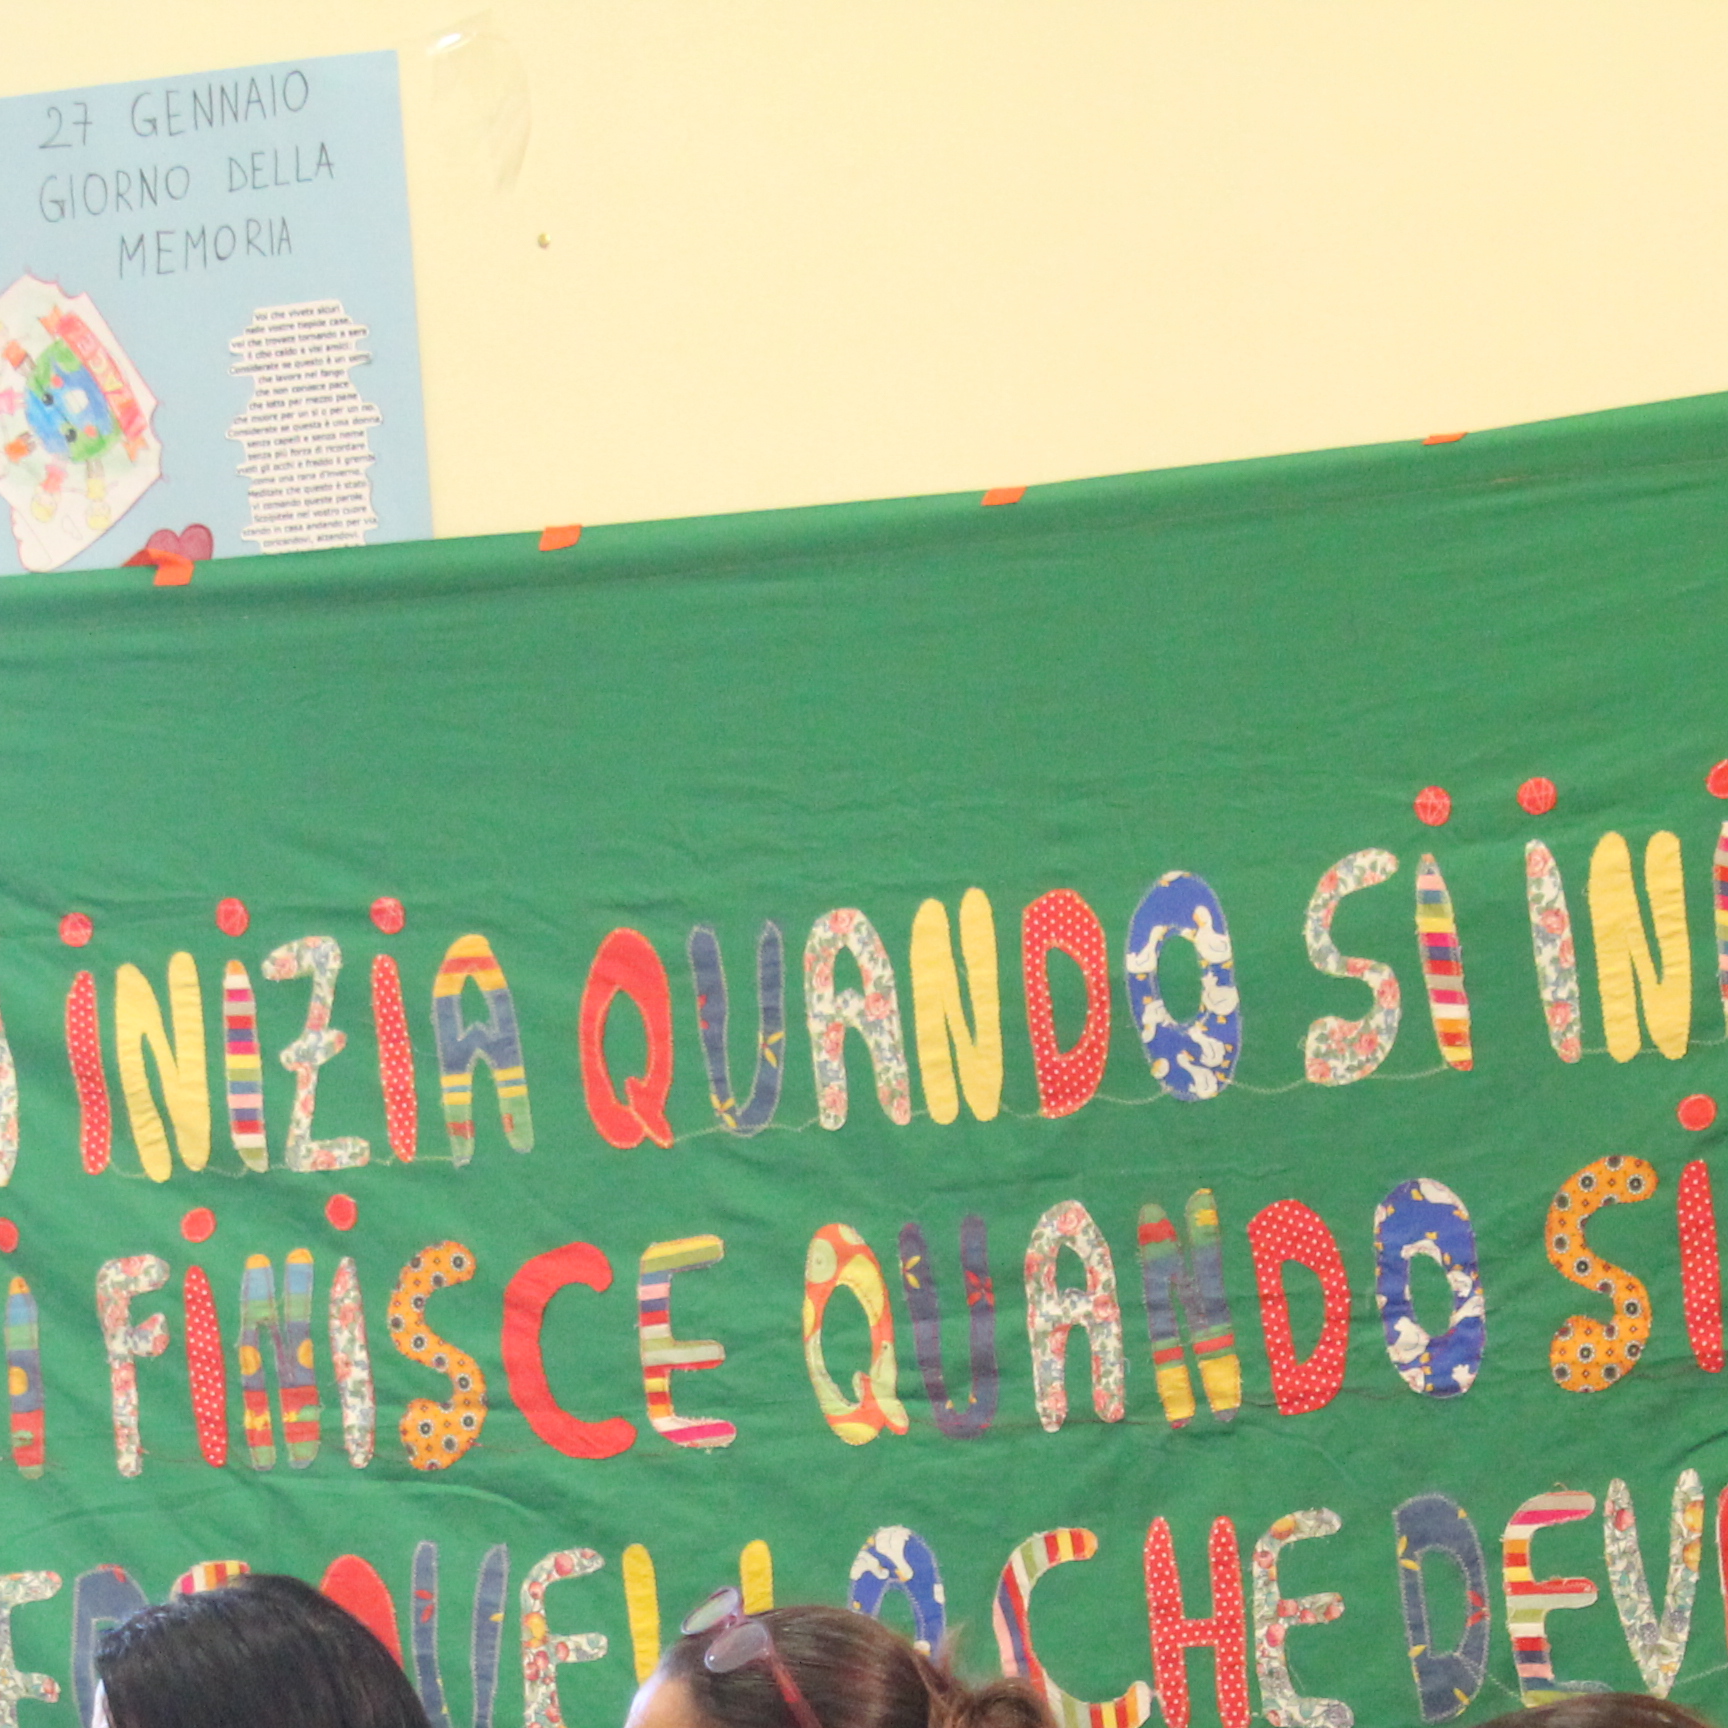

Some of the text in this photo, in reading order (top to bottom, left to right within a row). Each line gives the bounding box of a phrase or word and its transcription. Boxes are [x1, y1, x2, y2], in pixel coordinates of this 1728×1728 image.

[39, 70, 309, 148] 27 GENNAIO
[40, 142, 334, 223] GIORNO DELLA
[120, 217, 292, 279] MEMORIA
[578, 870, 1242, 1149] QUANDO
[803, 1177, 1486, 1445] QUANDO
